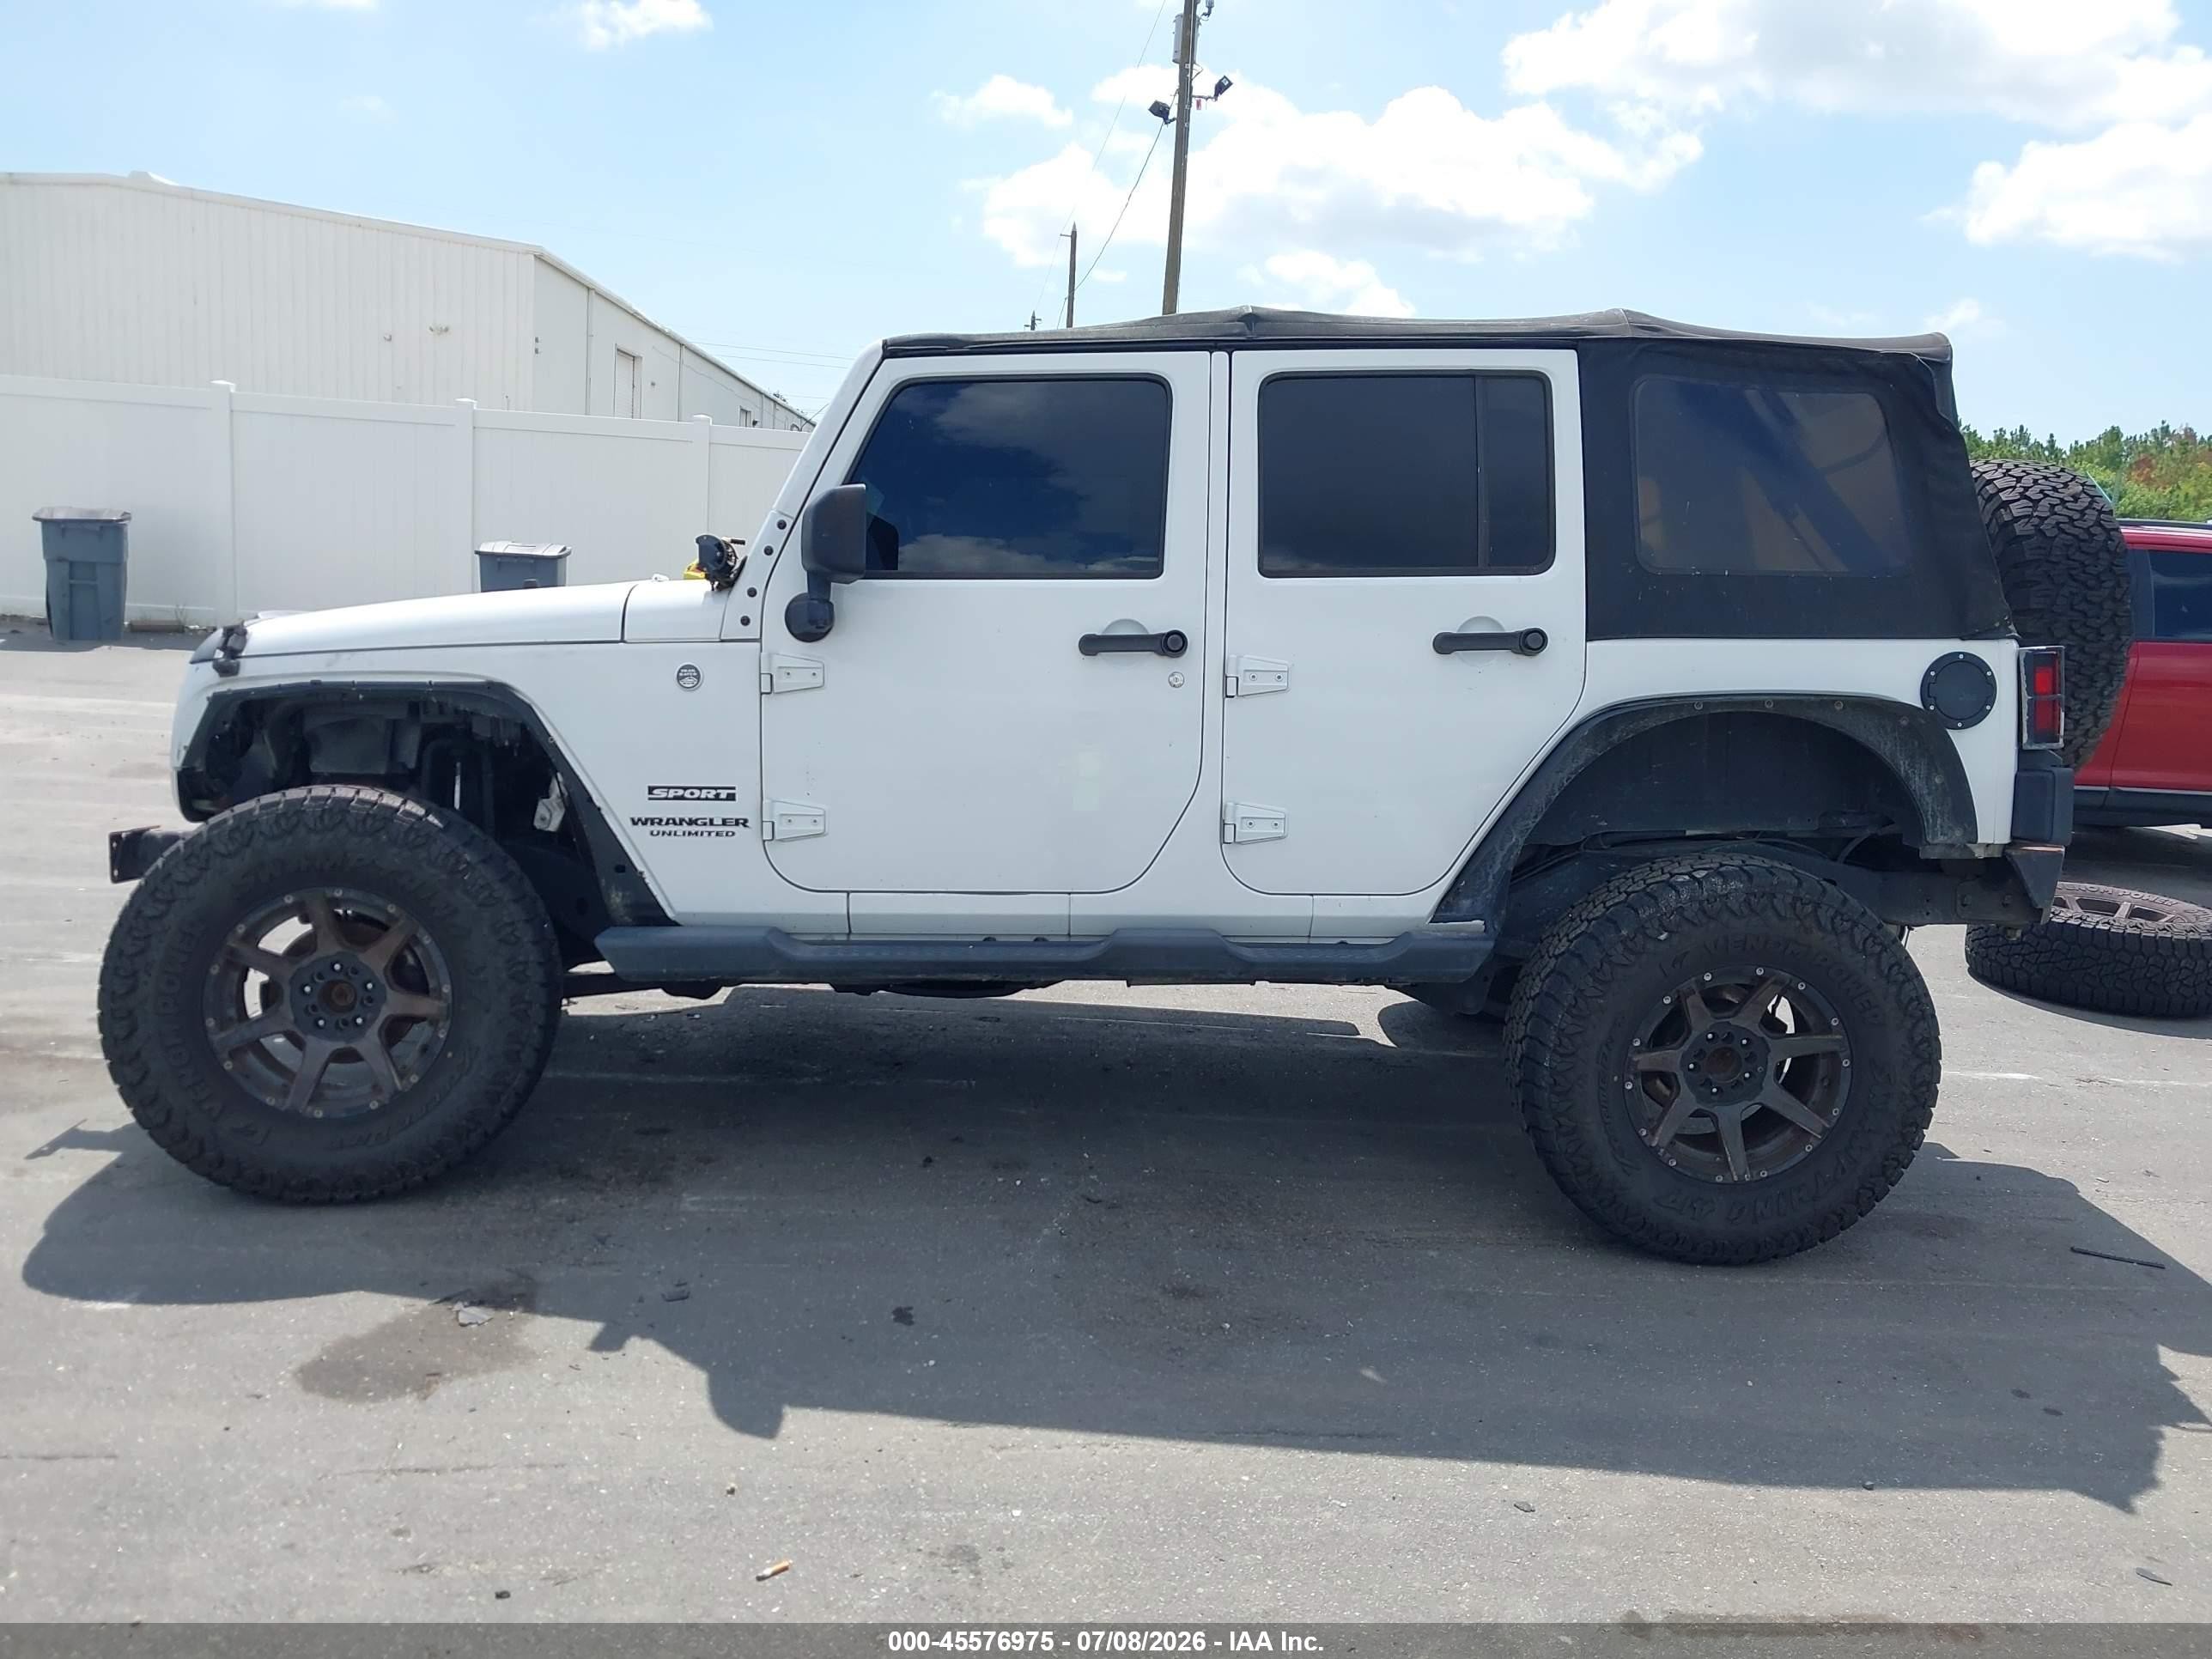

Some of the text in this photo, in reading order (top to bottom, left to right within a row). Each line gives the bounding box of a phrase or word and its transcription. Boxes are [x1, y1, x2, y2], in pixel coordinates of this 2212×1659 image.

[648, 786, 736, 800] SPORT
[630, 817, 751, 829] WRANGLER
[2118, 890, 2179, 907] POWER
